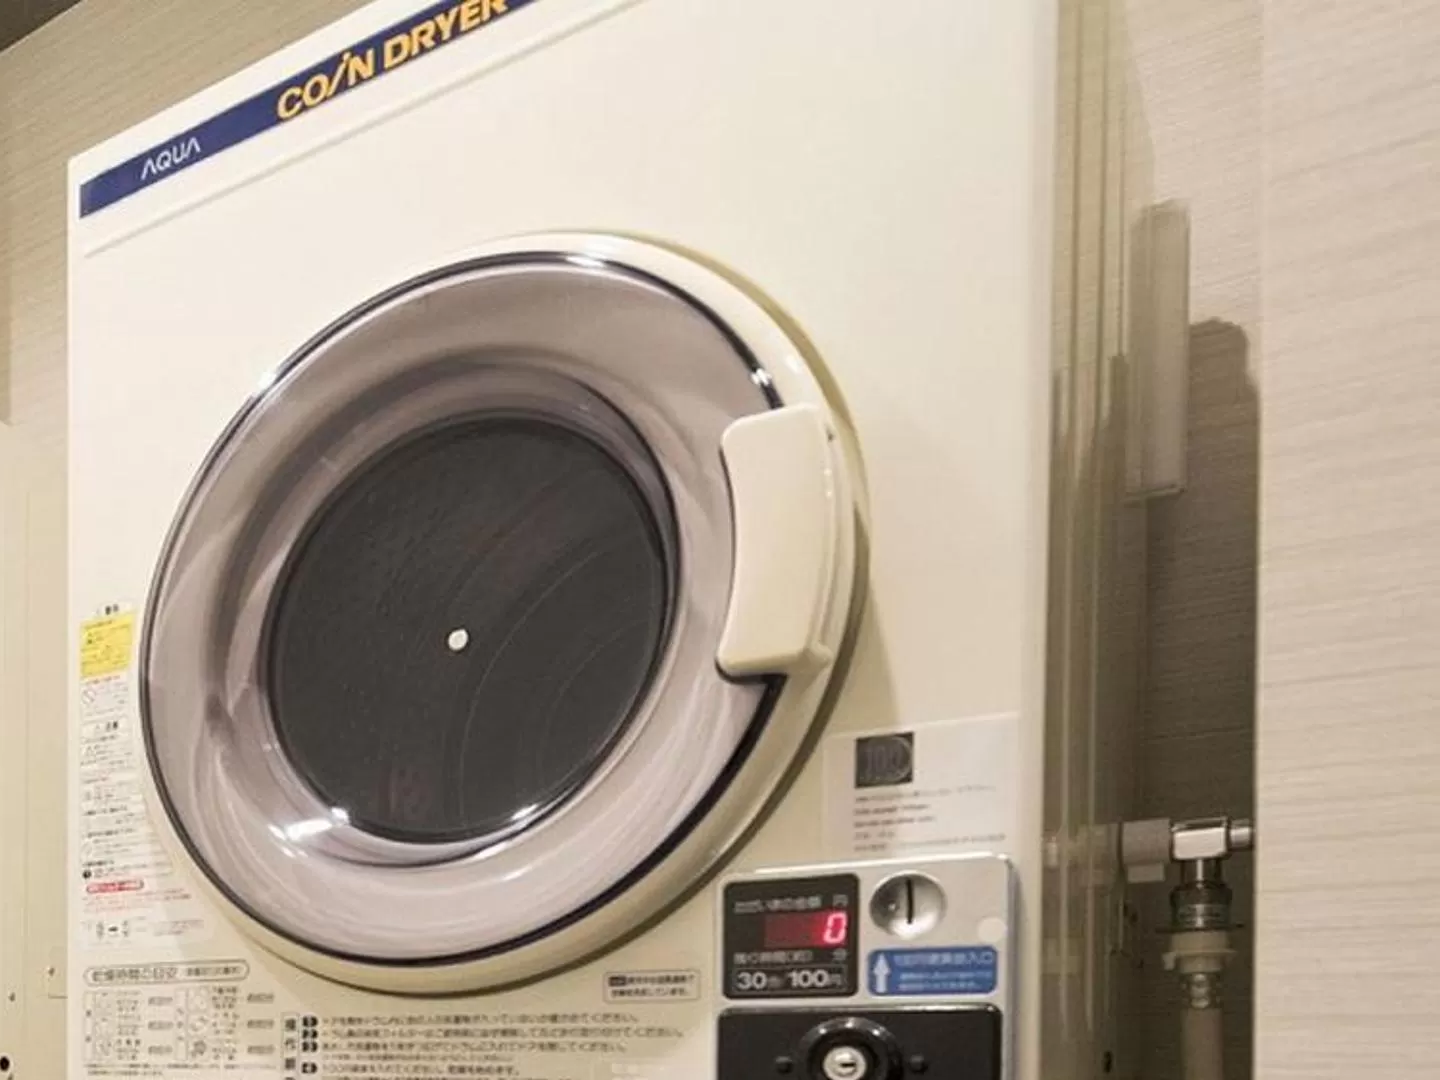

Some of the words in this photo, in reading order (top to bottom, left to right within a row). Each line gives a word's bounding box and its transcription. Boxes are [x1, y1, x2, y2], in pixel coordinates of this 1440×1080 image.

[141, 136, 202, 181] AQUA
[276, 48, 375, 121] COIN
[823, 911, 848, 944] 0
